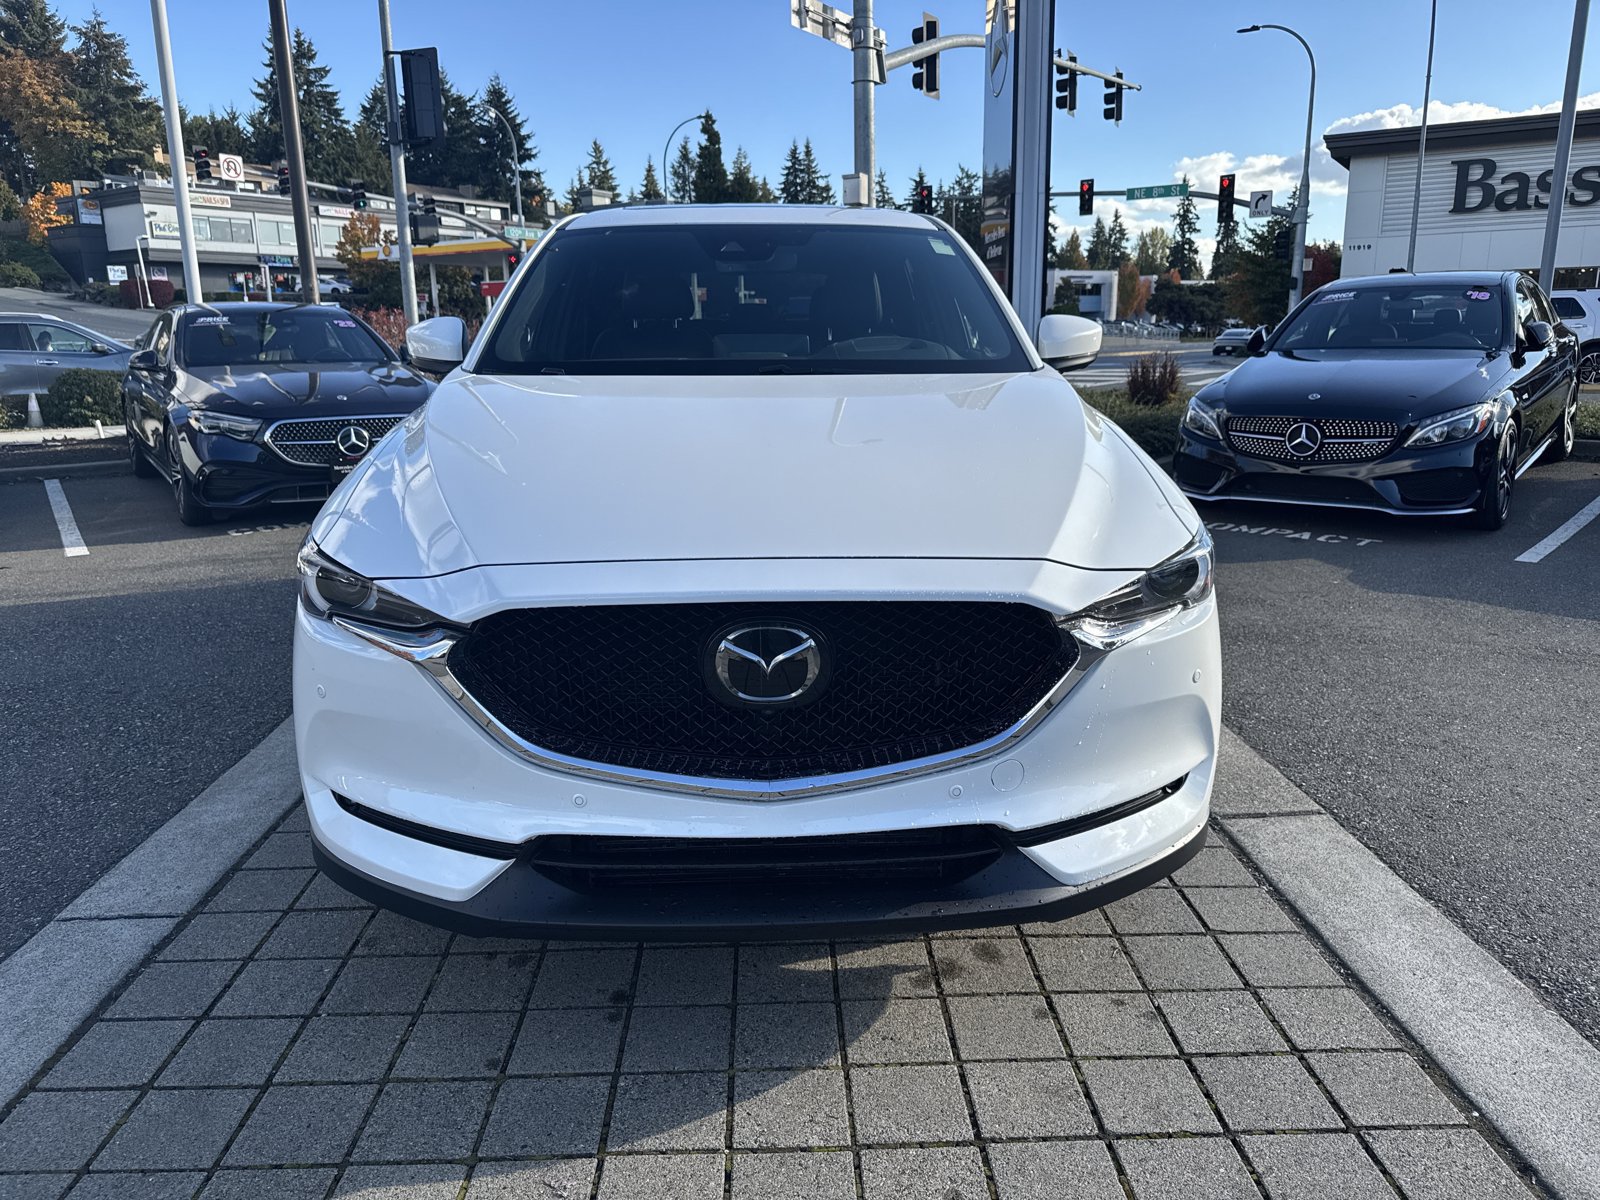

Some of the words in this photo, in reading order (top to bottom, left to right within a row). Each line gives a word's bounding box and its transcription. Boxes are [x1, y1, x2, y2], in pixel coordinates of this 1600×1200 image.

[1134, 189, 1146, 199] NE
[1152, 187, 1165, 198] 8th
[1170, 185, 1180, 196] St
[1252, 209, 1269, 217] ONLY
[1203, 520, 1384, 547] OMPACT
